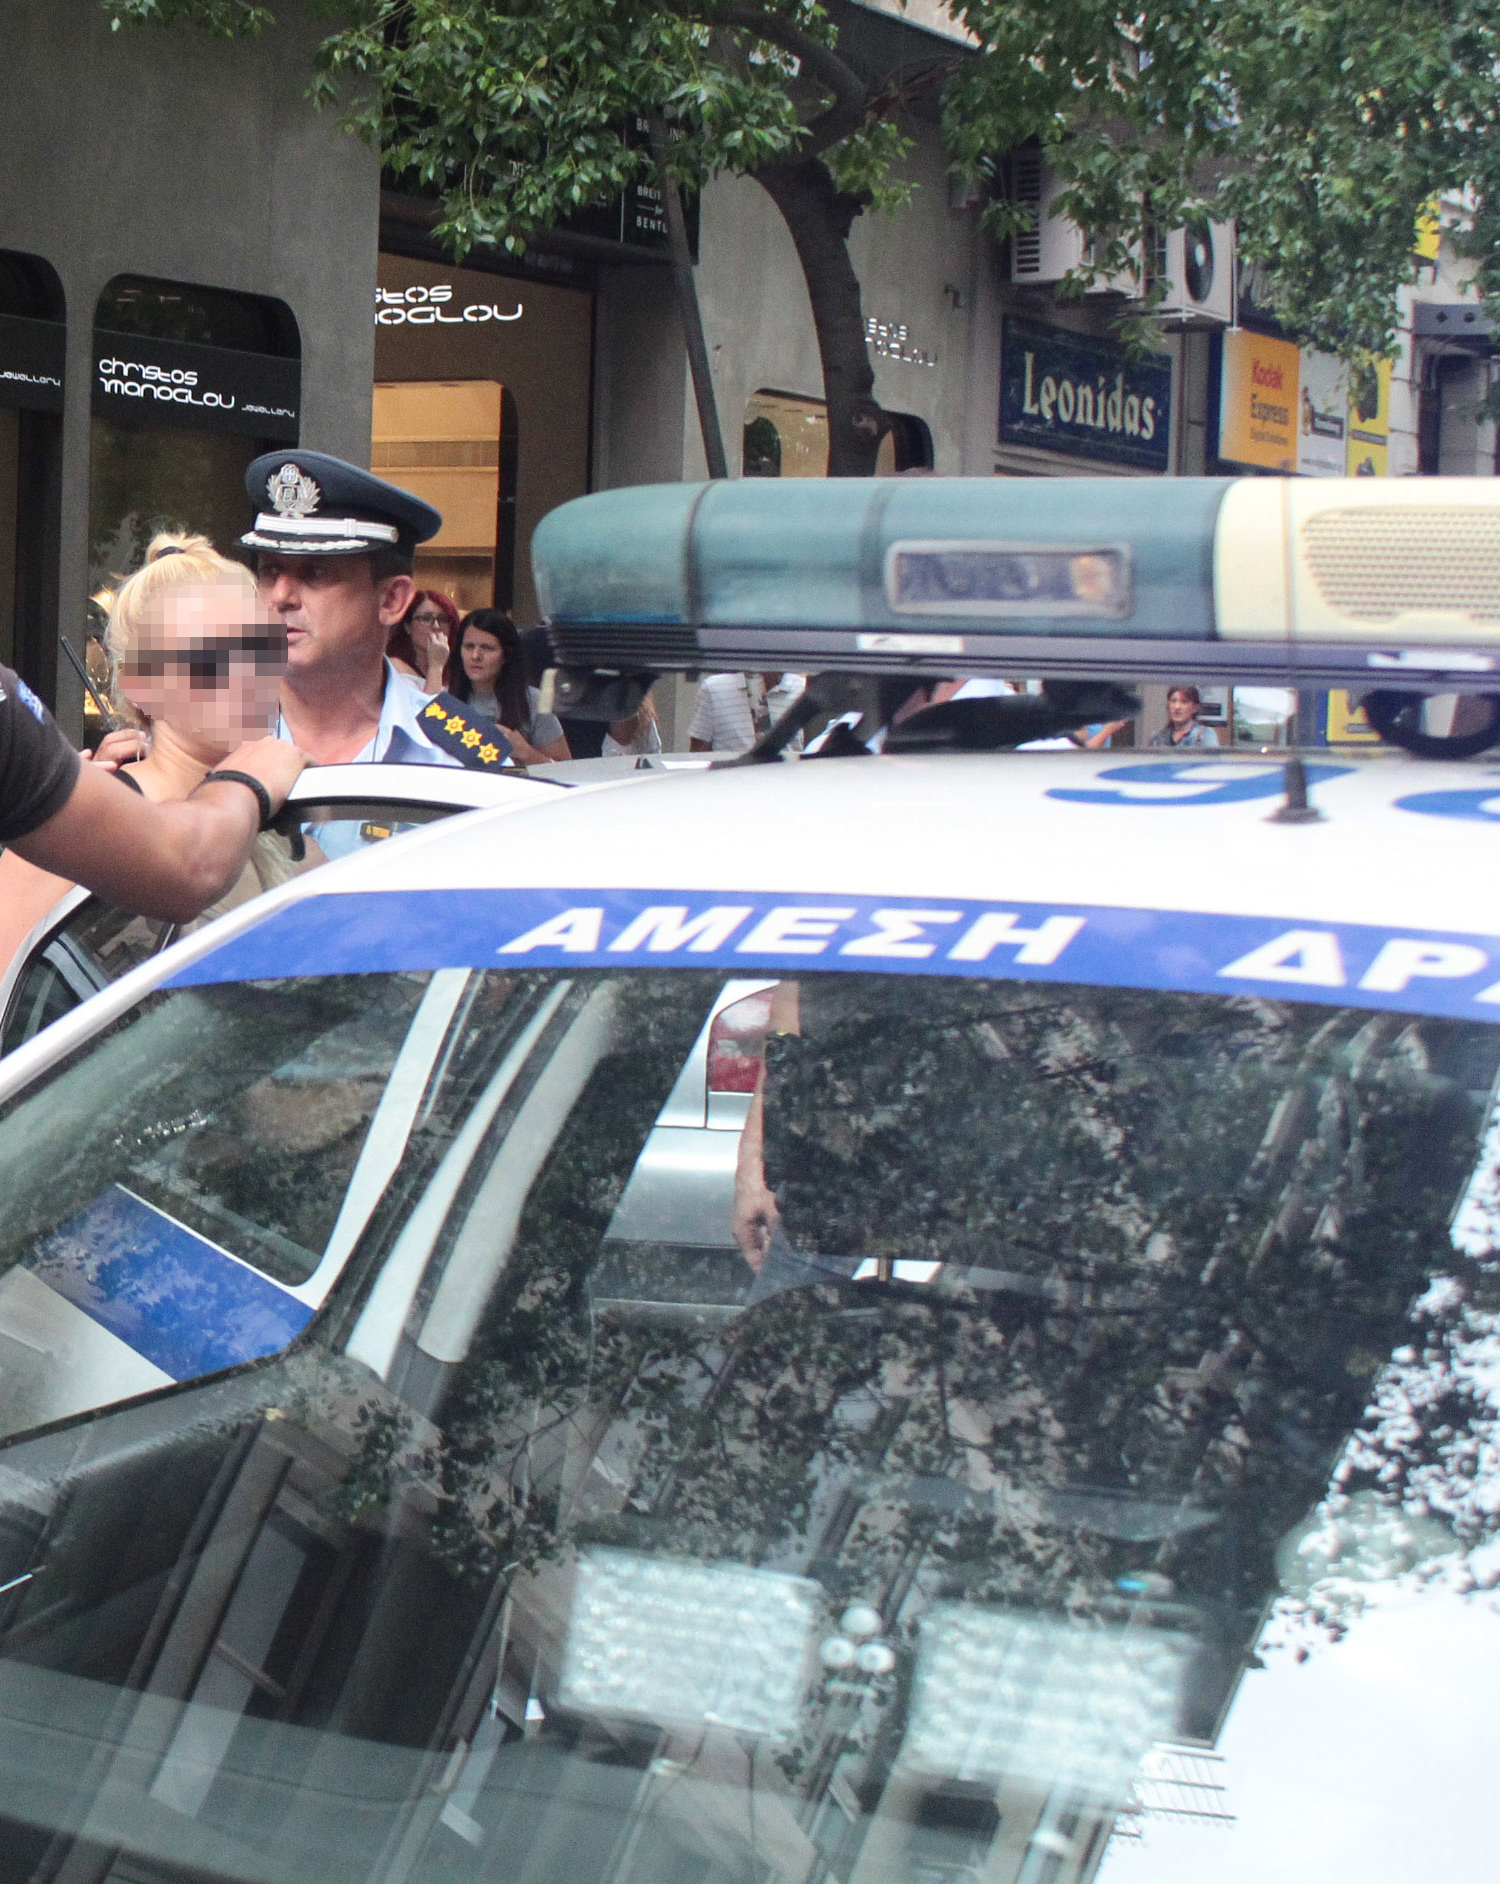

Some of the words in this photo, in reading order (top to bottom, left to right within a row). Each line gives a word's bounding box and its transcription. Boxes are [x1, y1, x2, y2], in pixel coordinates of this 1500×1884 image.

[635, 215, 668, 233] BENTL
[1022, 351, 1156, 440] Leonidas
[1252, 357, 1284, 391] Kodak
[496, 905, 1088, 966] ΑΜΕΣΗ
[1215, 928, 1500, 1005] ΔΡ
